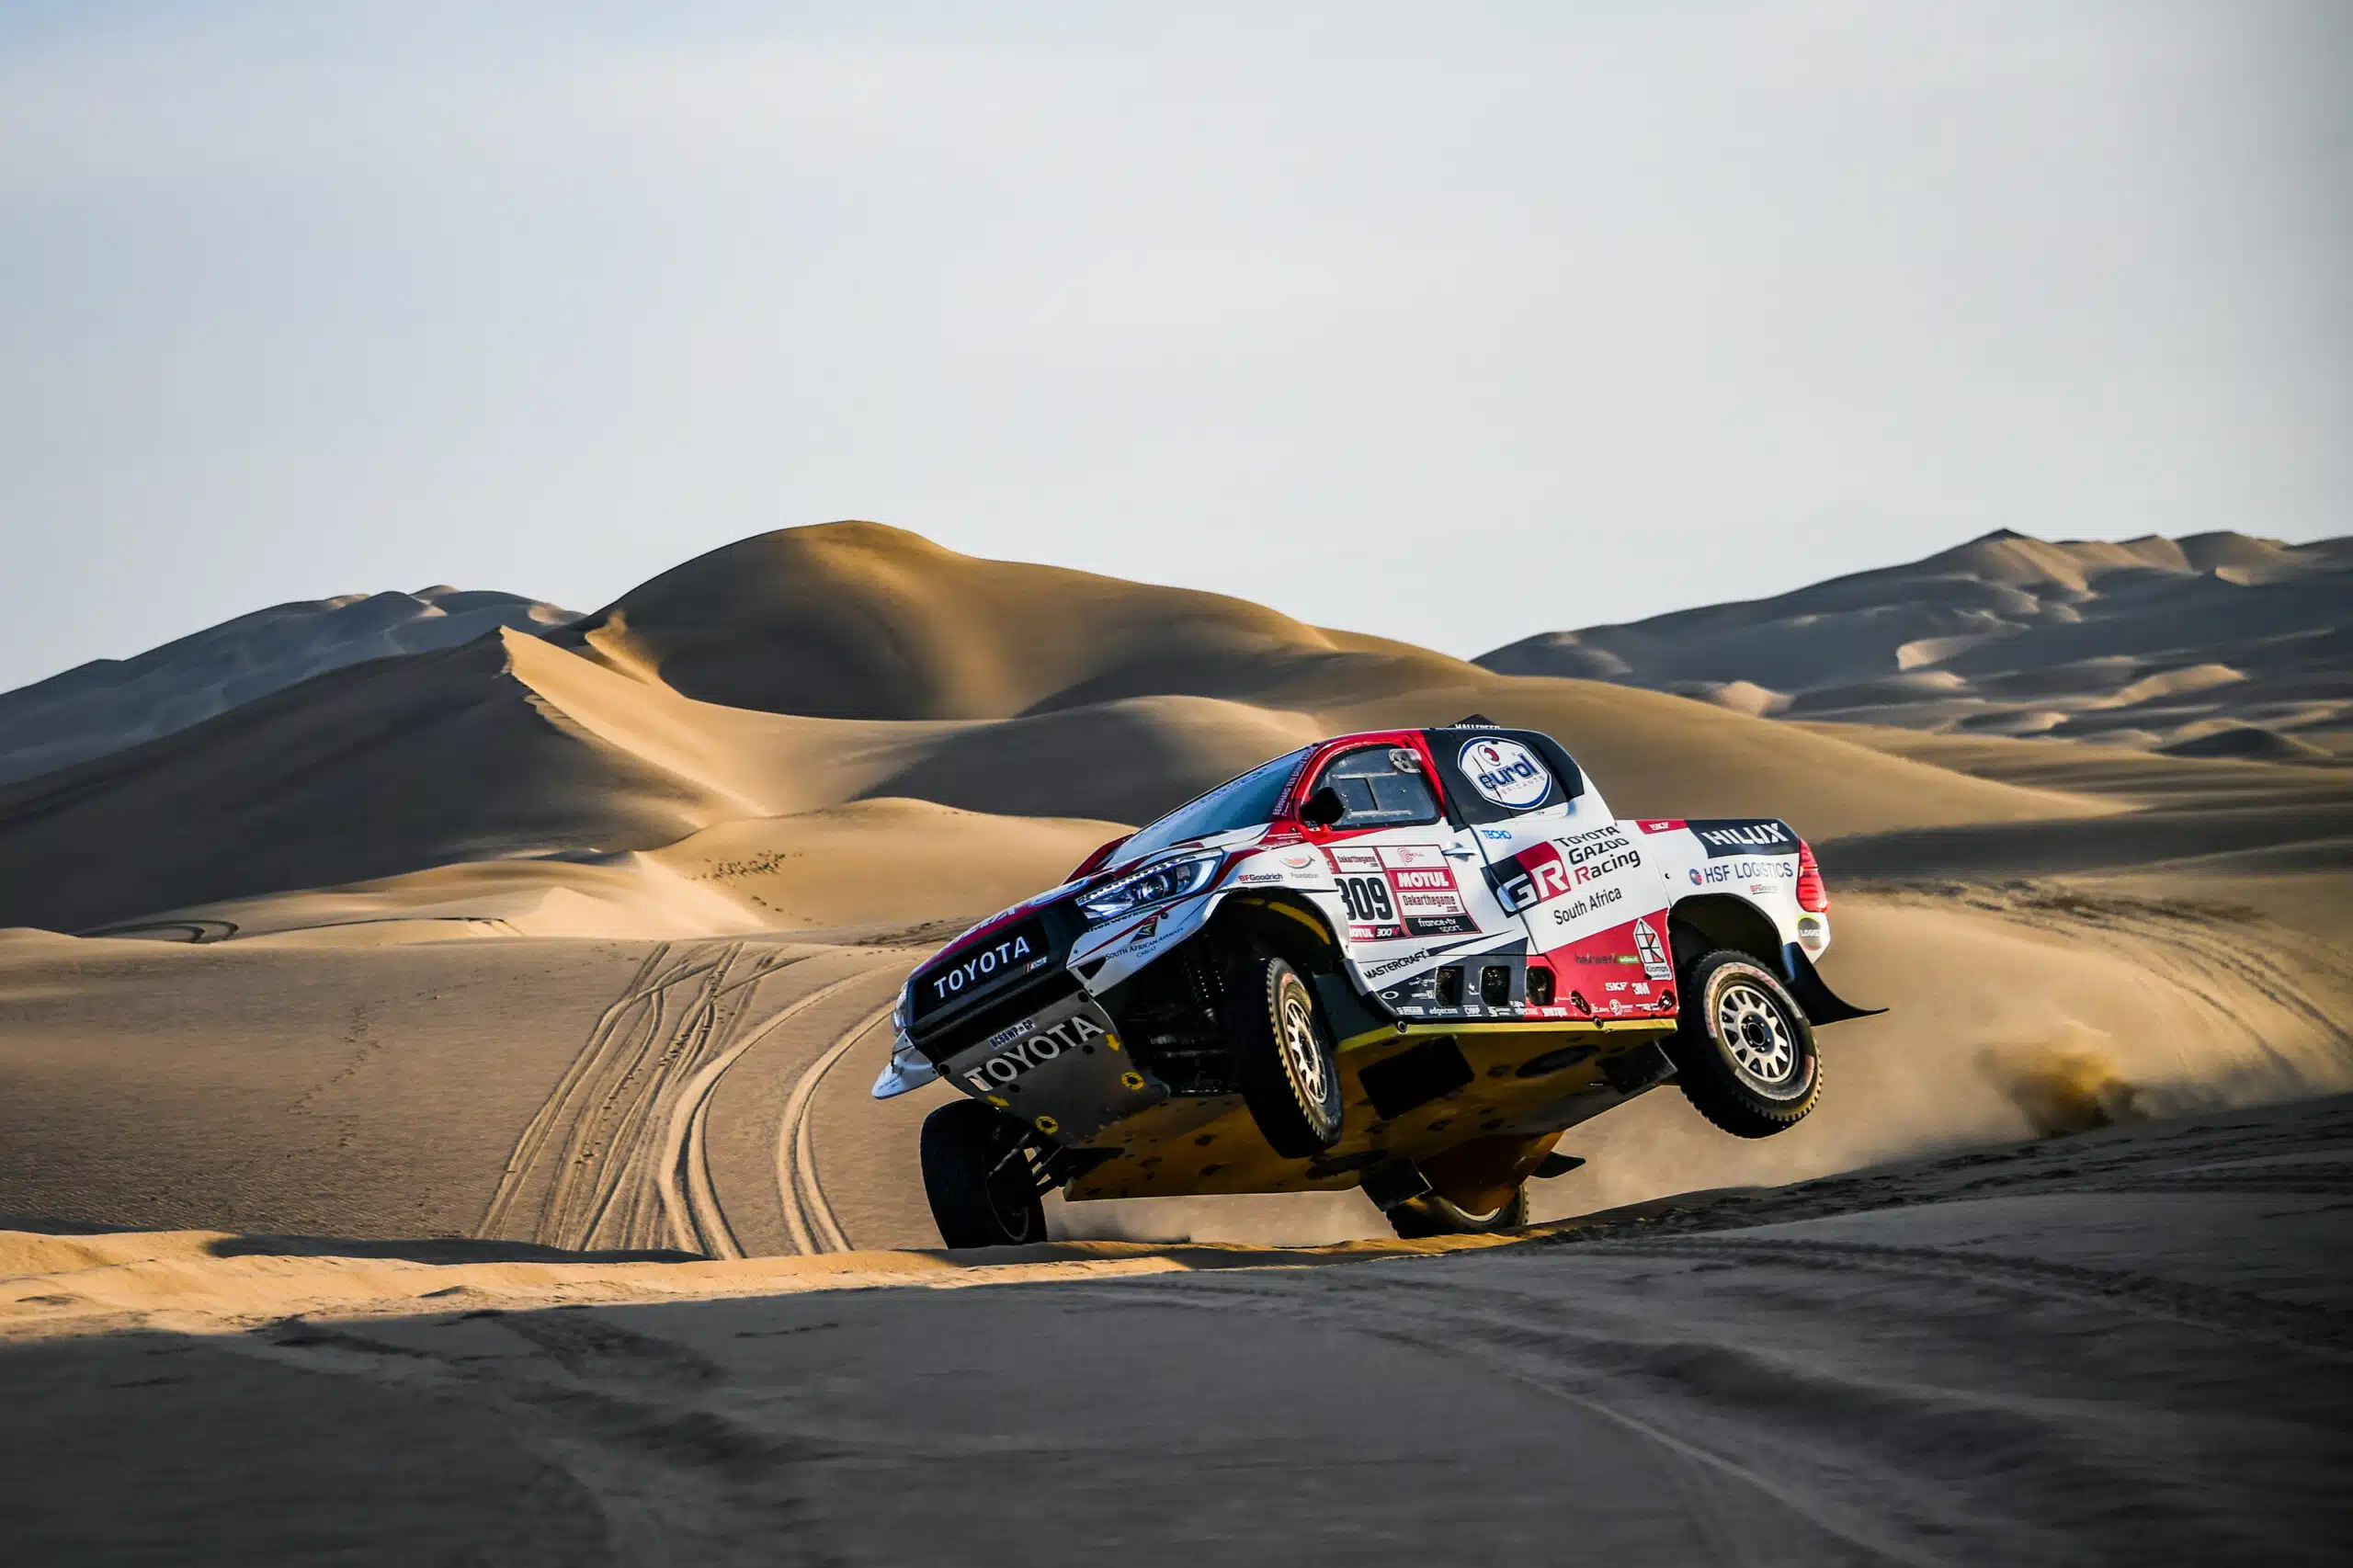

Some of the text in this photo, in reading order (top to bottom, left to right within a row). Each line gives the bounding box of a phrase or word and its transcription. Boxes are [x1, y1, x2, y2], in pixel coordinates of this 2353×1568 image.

[1477, 754, 1540, 790] eurol
[1481, 830, 1513, 840] TECHO
[1552, 826, 1620, 847] TOYOTA
[1649, 822, 1669, 831] SKF
[1701, 823, 1789, 846] HILUX
[1568, 837, 1630, 865] GAZOO
[1238, 872, 1284, 882] BFGoodrich
[1574, 849, 1641, 884] Racing
[1704, 862, 1793, 883] HSF LOGISTICS
[1396, 871, 1449, 888] MOTUL
[1496, 858, 1570, 913] GR
[1334, 877, 1393, 921] 309
[1403, 894, 1456, 907] Dakarthegame
[1553, 887, 1622, 925] South Africa
[1349, 926, 1375, 937] OTUL
[1106, 948, 1128, 960] SOUTH
[1129, 939, 1158, 953] AFRICAN
[933, 936, 1031, 999] TOYOTA
[1363, 950, 1427, 979] MASTERCRAFT
[1605, 982, 1651, 995] SKF 3M
[963, 1016, 1105, 1092] TOYOTA
